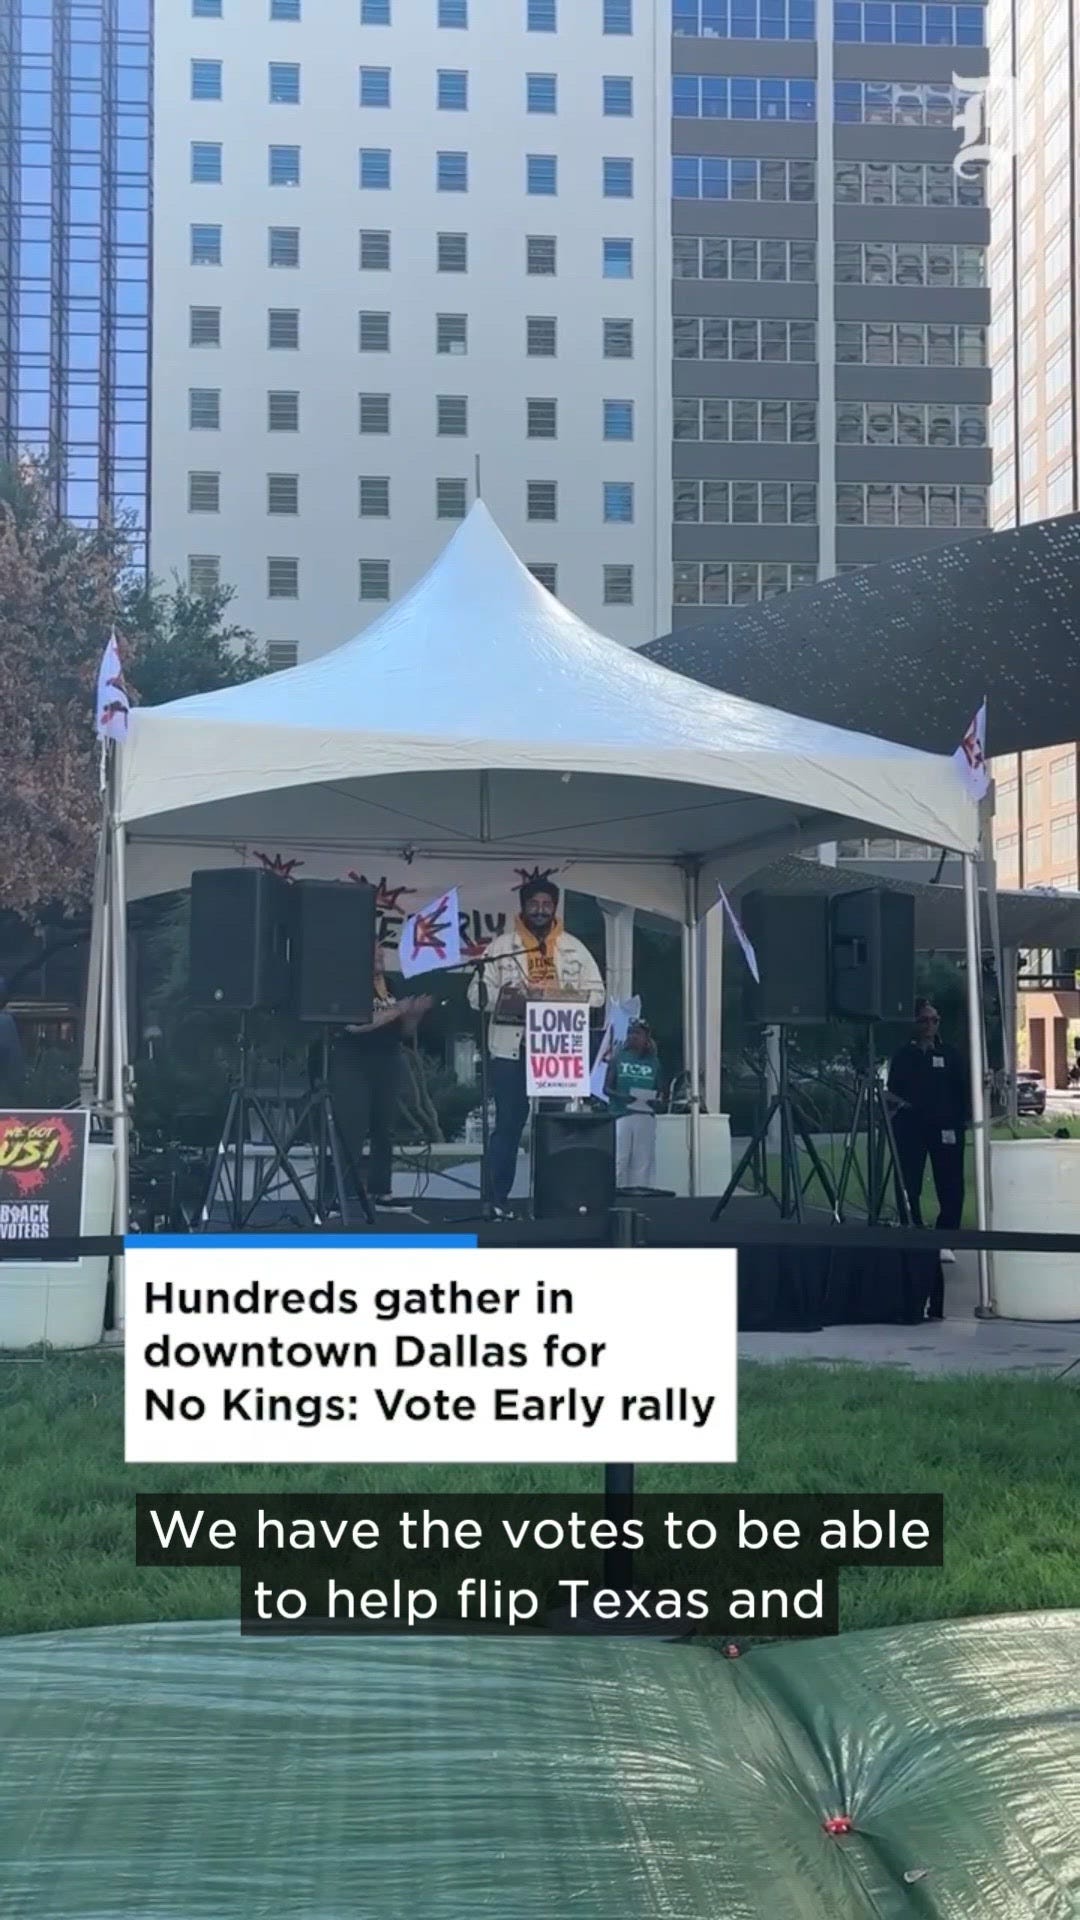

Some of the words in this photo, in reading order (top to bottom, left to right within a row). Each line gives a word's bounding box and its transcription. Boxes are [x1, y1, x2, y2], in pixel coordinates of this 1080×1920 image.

[529, 1009, 586, 1032] LONG
[530, 1033, 569, 1054] LIVE
[530, 1055, 583, 1079] VOTE
[4, 1126, 27, 1138] WE
[28, 1126, 57, 1139] GOT
[0, 1139, 60, 1168] US!
[0, 1222, 49, 1239] VOTERS
